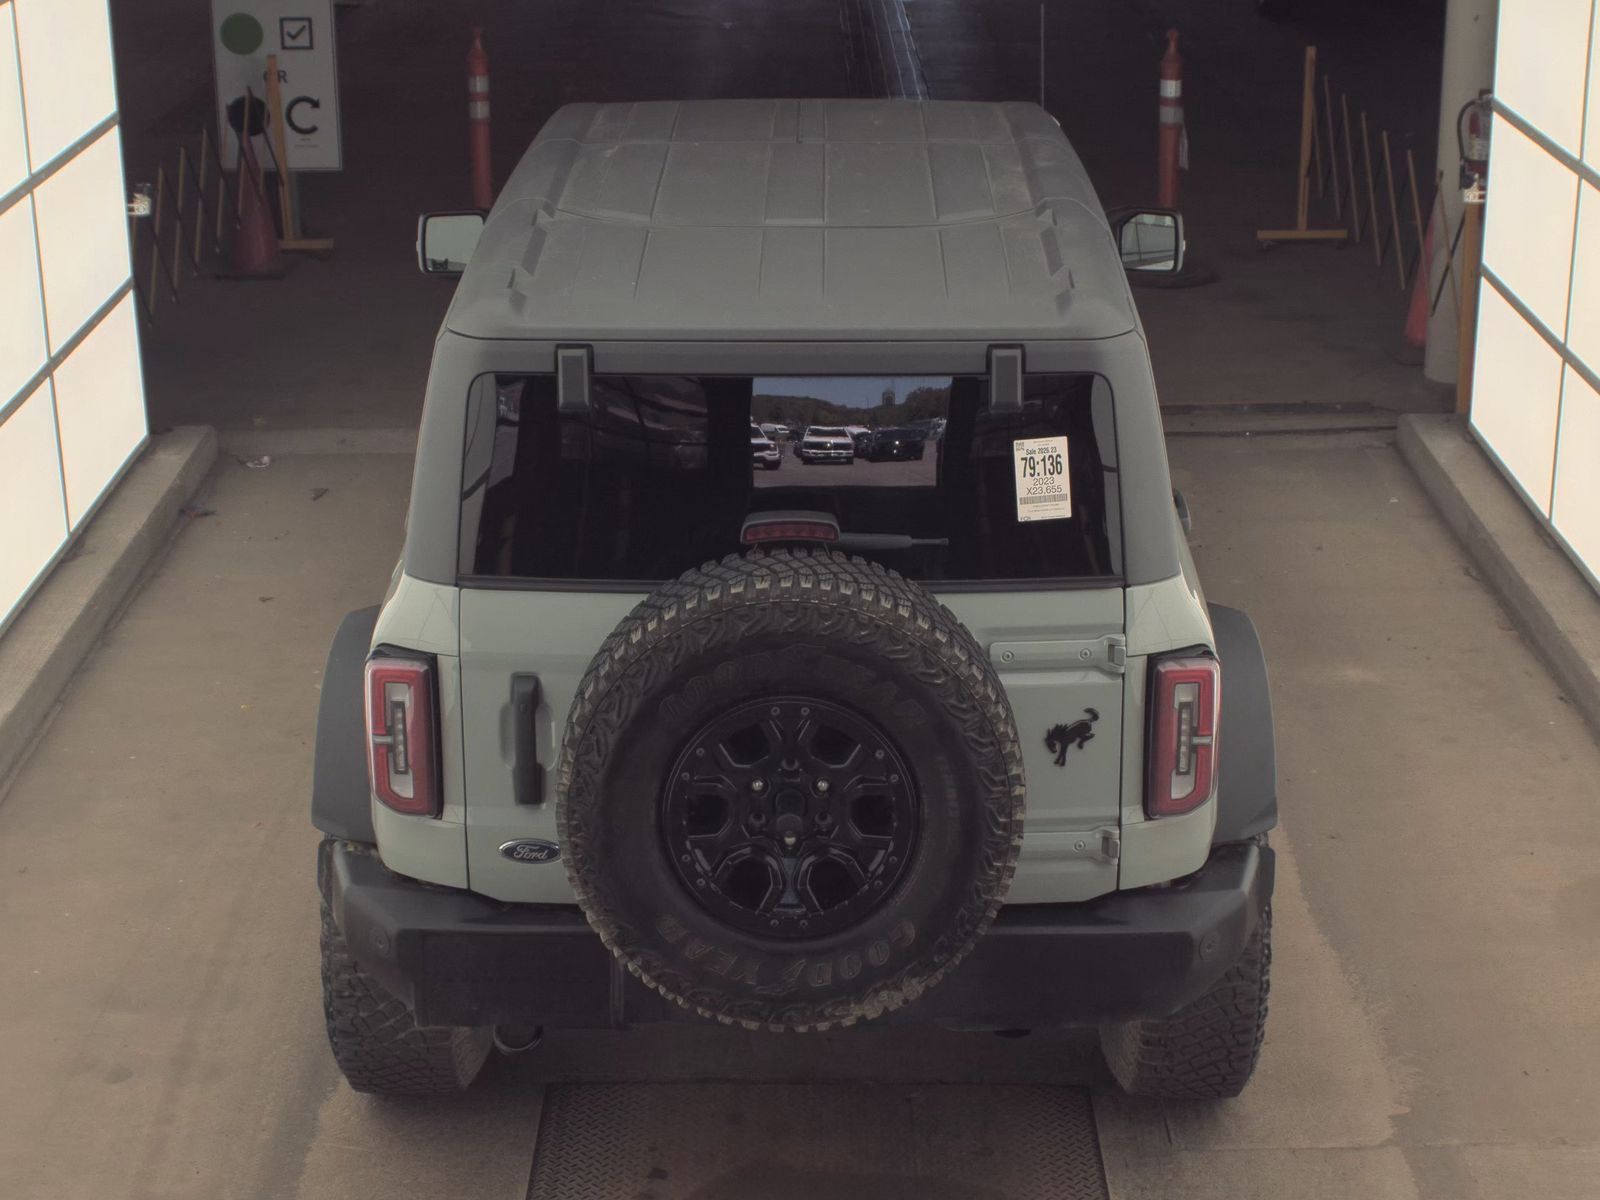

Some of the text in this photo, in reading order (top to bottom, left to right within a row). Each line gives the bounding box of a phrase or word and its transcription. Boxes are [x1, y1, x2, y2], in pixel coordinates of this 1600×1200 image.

[1020, 454, 1063, 478] 79:136
[1033, 477, 1055, 486] 2023
[513, 844, 548, 859] Ford
